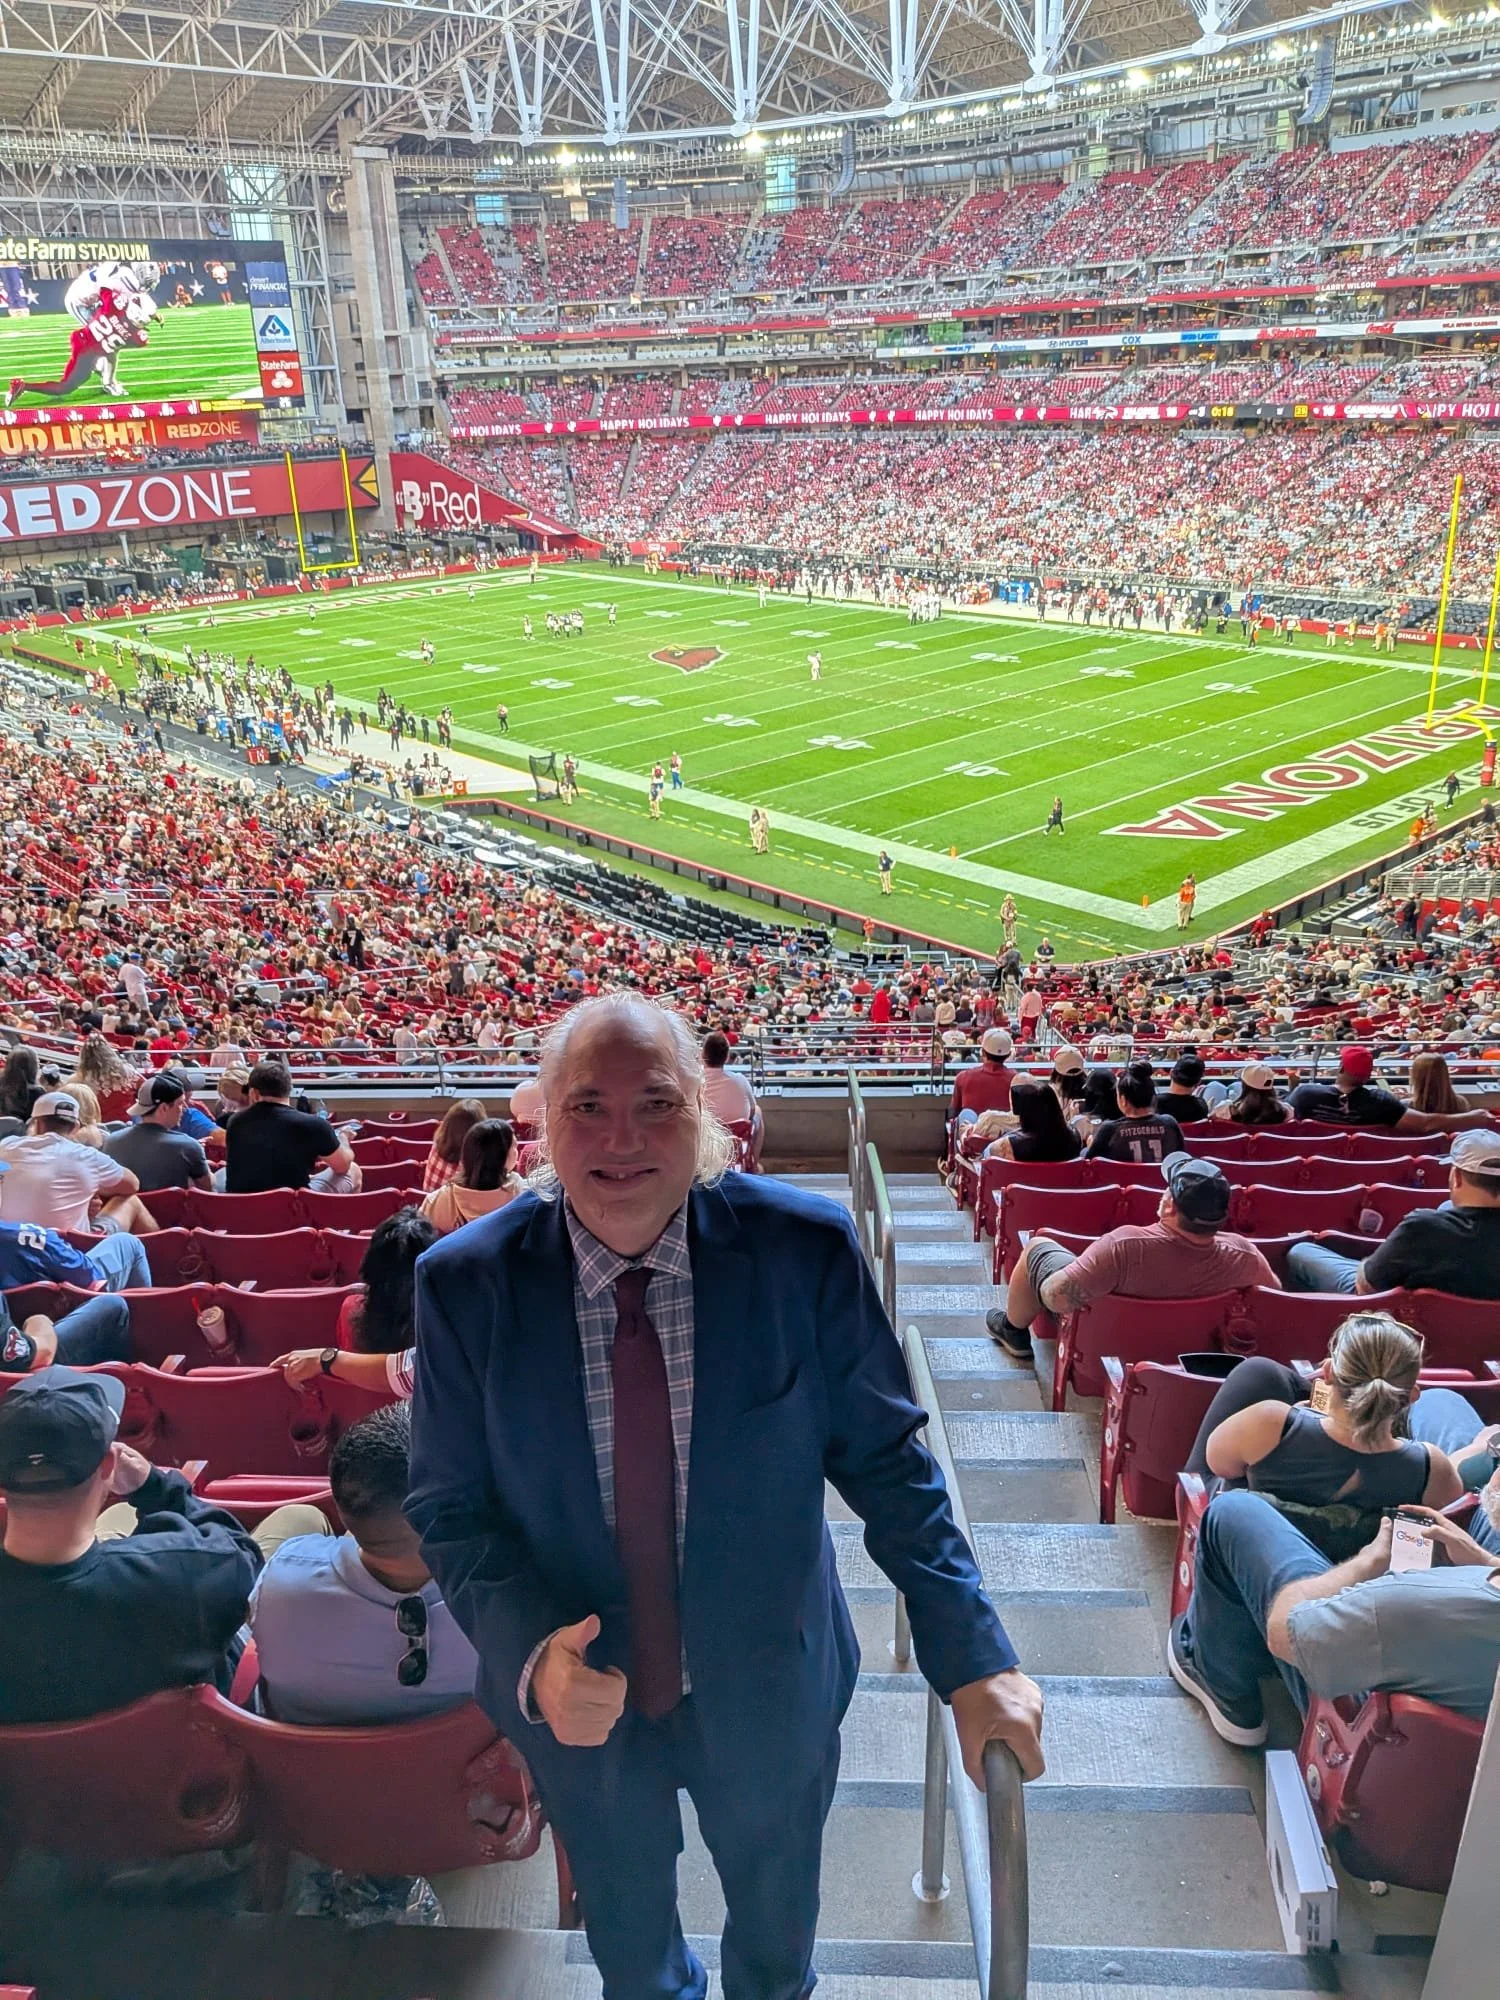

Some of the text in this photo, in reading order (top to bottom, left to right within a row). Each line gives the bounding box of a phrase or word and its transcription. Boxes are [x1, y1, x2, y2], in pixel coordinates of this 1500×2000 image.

[79, 243, 151, 260] STADIUM
[1321, 281, 1377, 292] LARRY WILSON
[1058, 339, 1088, 347] HYUNDAI
[1122, 336, 1141, 345] COX
[765, 411, 851, 424] HAPPY HOLIDAYS
[915, 408, 994, 421] HAPPY HOLIDAYS
[470, 423, 522, 436] HOLIDAYS
[601, 417, 690, 430] HAPPY HOLIDAYS
[52, 419, 147, 451] LIGHT
[397, 568, 436, 579] CARDINALS
[193, 592, 239, 605] CARDINALS
[807, 735, 875, 750] 20
[1349, 811, 1403, 829] US
[1120, 1125, 1165, 1137] FITZGERALD
[1128, 1139, 1163, 1163] 11
